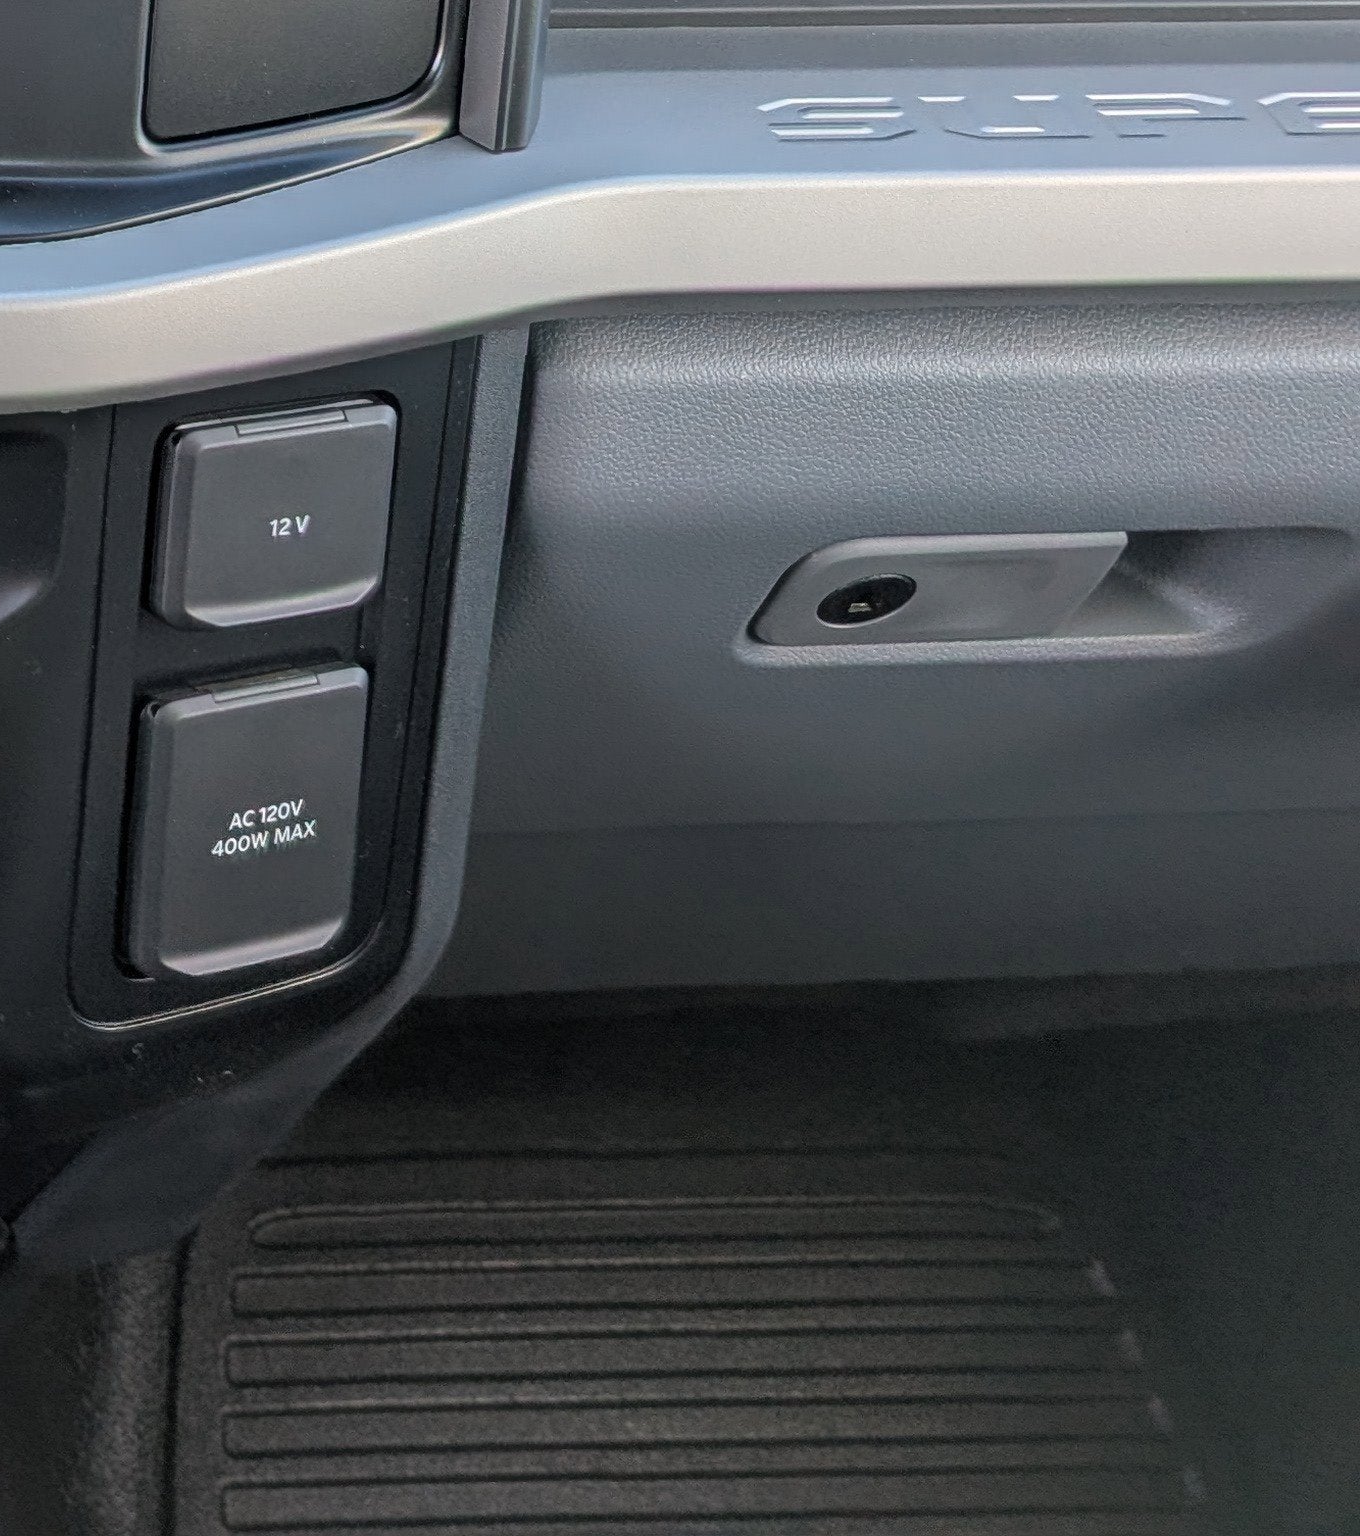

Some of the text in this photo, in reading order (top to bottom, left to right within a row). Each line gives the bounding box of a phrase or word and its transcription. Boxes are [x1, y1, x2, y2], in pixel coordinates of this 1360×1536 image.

[269, 514, 311, 537] 12 V
[228, 798, 304, 831] AC 120V
[210, 818, 317, 857] 400W MAX
